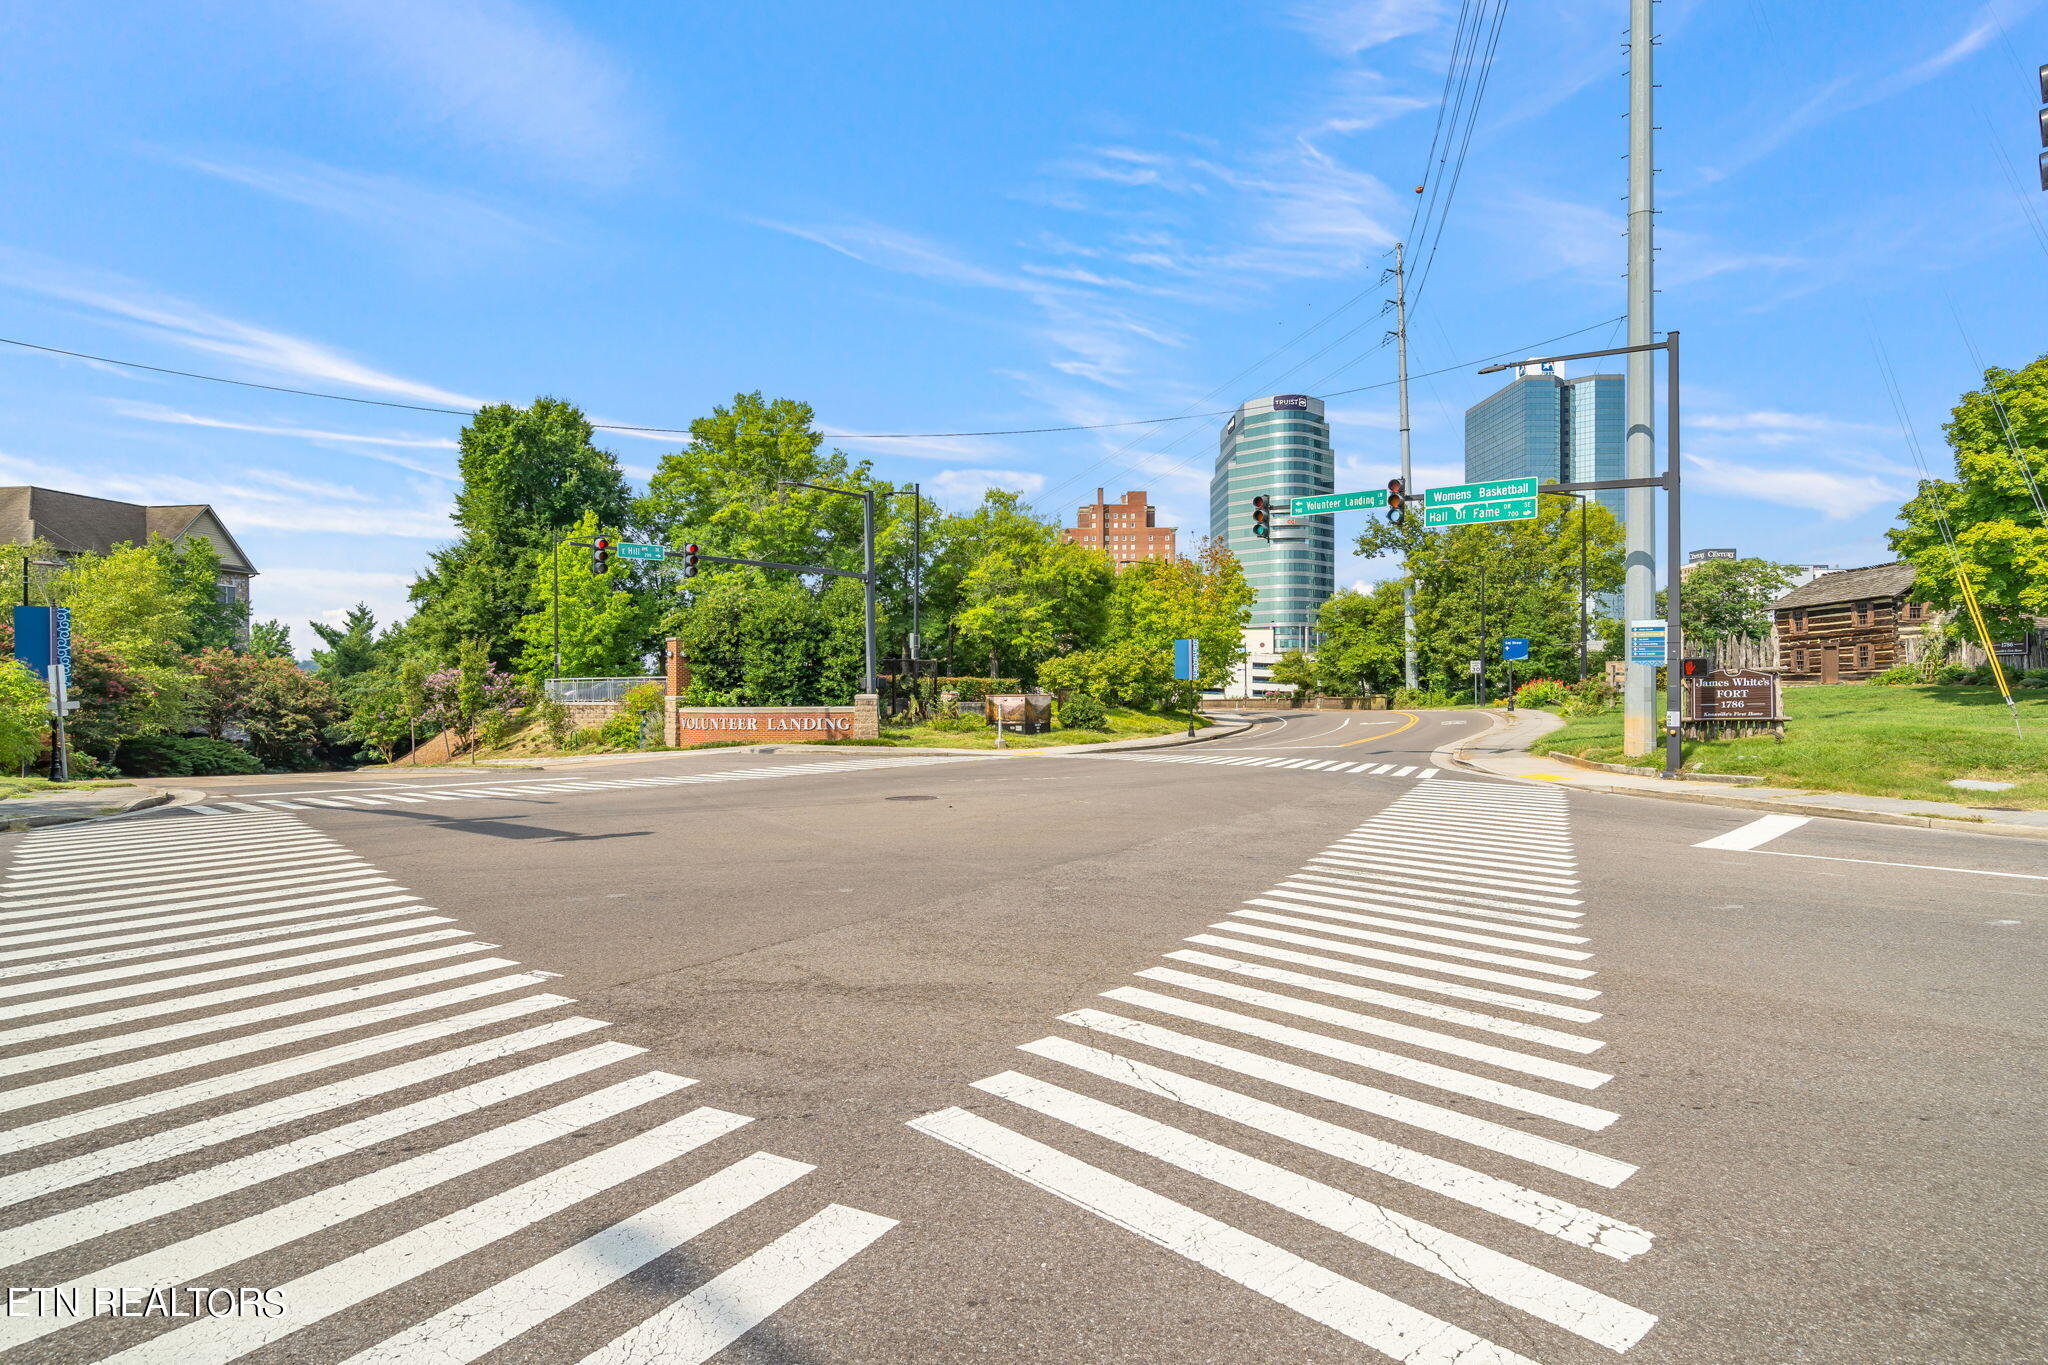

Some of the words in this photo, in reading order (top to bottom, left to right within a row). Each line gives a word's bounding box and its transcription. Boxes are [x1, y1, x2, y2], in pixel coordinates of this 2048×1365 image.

[1433, 490, 1472, 502] Womens
[1479, 483, 1529, 498] Basketball
[1306, 499, 1341, 511] Volunteer
[1345, 496, 1375, 507] Landing
[1429, 511, 1448, 522] Hall
[1455, 509, 1466, 520] Of
[1473, 507, 1500, 519] Fame
[627, 547, 640, 555] Hill
[1696, 678, 1729, 687] James
[1732, 677, 1770, 687] White's
[1716, 689, 1749, 698] FORT
[1720, 700, 1745, 709] 1786
[681, 717, 758, 731] VOLUNTEER
[767, 718, 850, 731] LANDING
